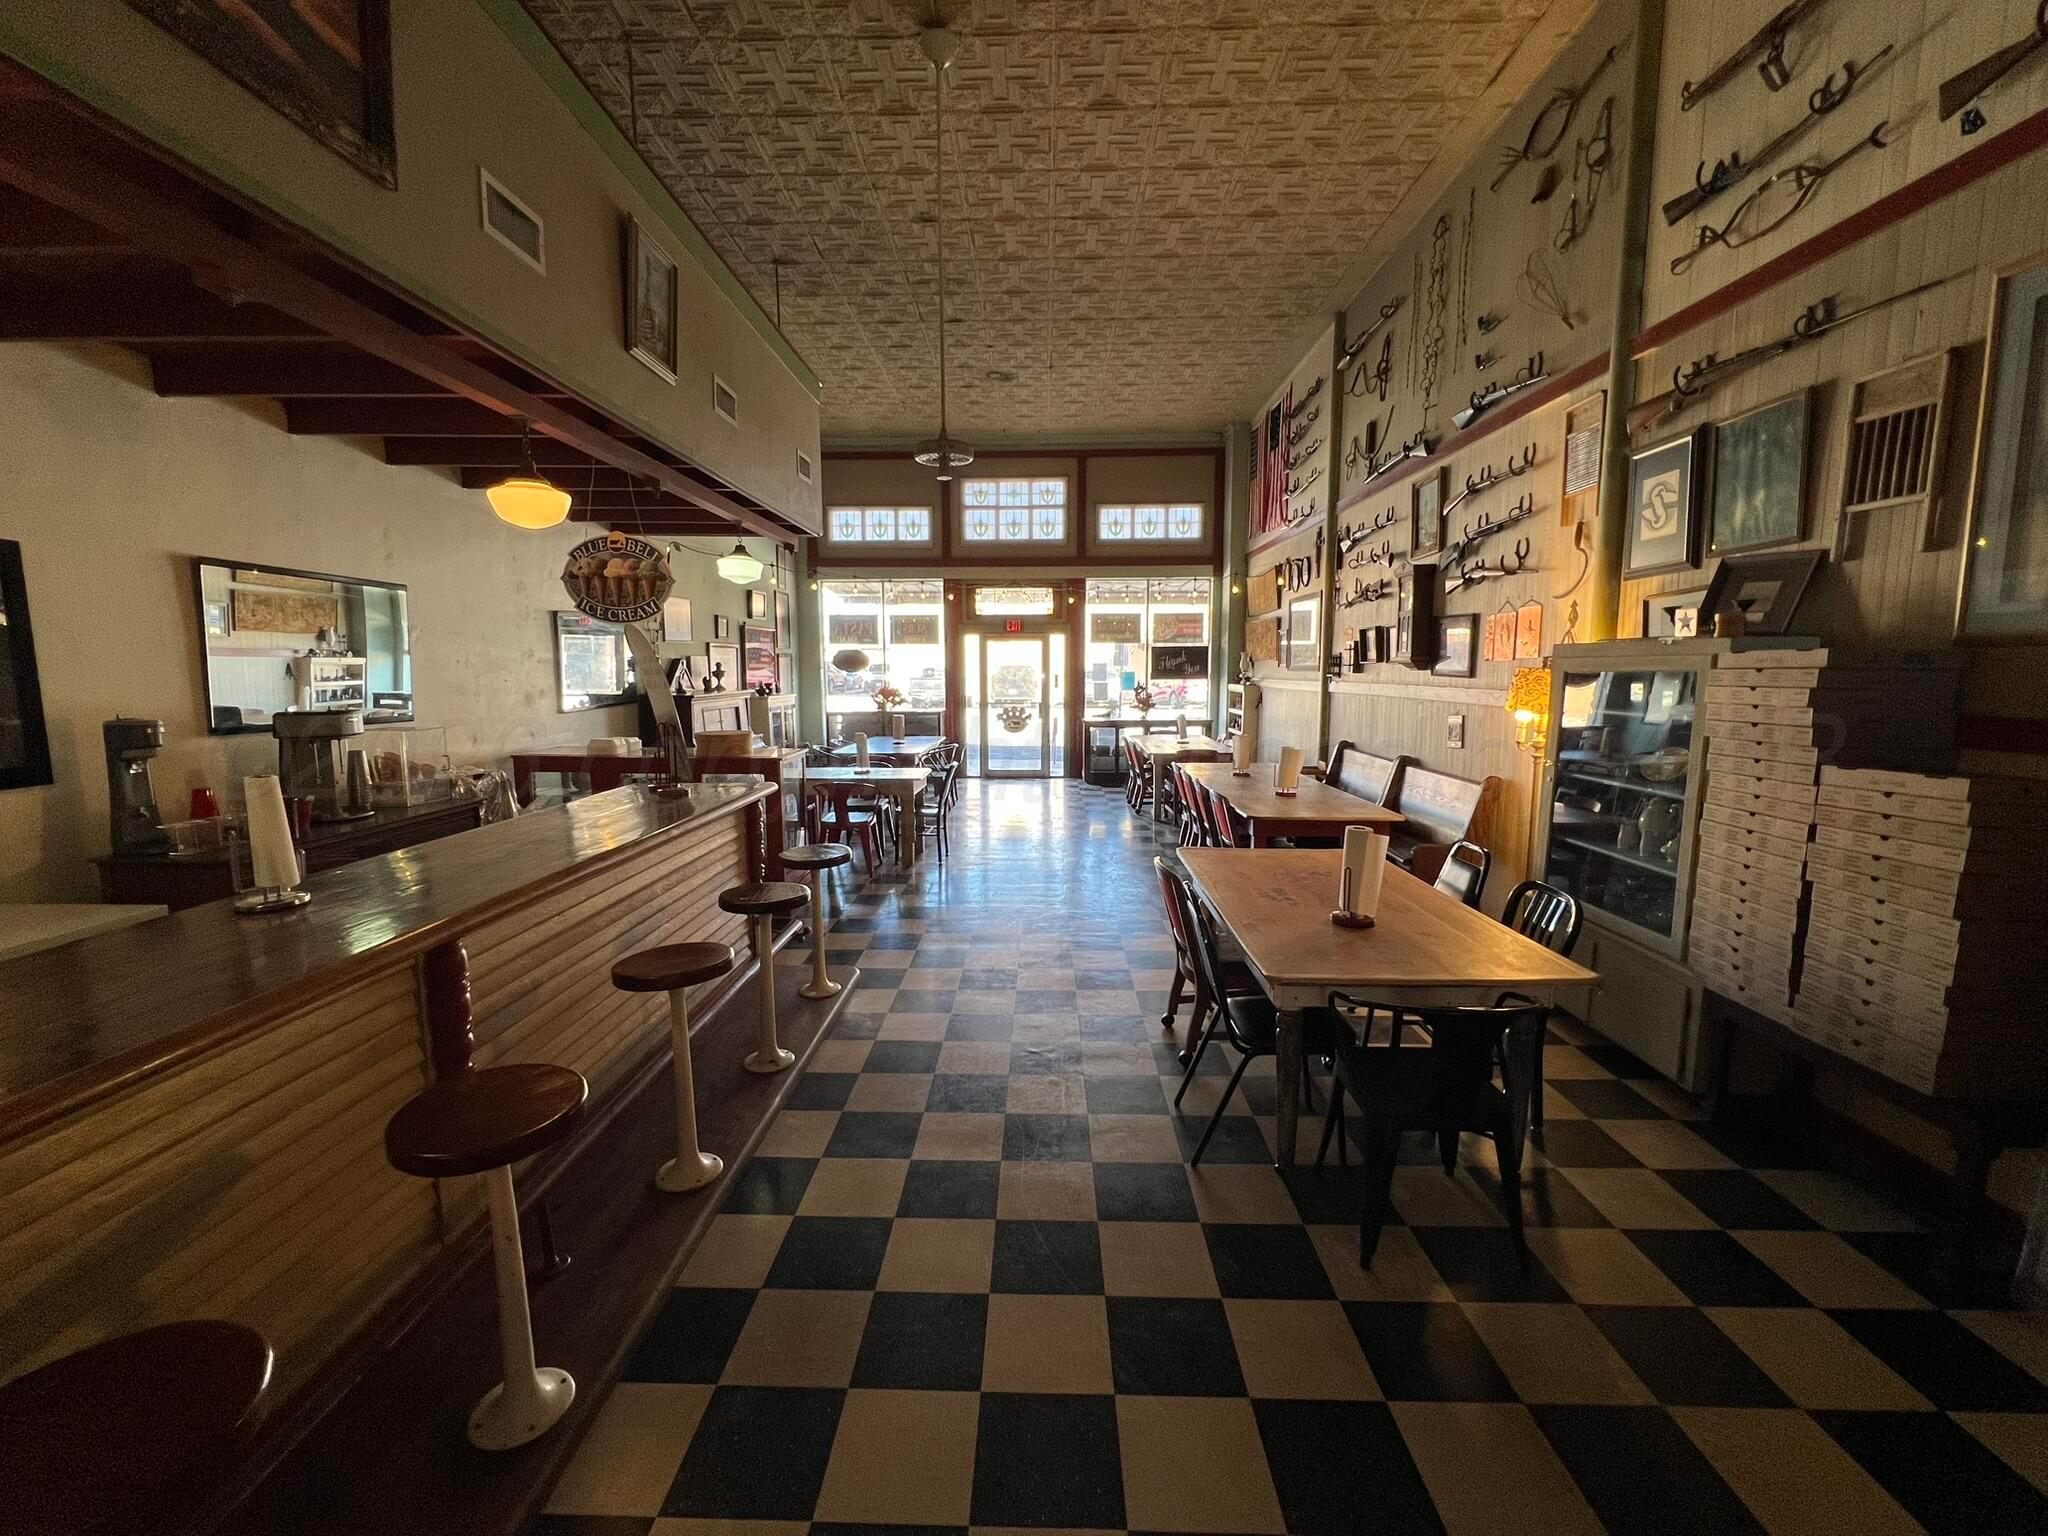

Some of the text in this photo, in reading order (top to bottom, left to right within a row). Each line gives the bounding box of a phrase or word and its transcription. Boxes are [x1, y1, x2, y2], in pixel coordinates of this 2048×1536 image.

[573, 539, 607, 561] BLUE
[580, 600, 605, 618] ICE
[608, 602, 658, 621] CREAM
[1006, 619, 1021, 631] EXIT
[1158, 650, 1187, 670] Thank
[1183, 663, 1200, 675] You
